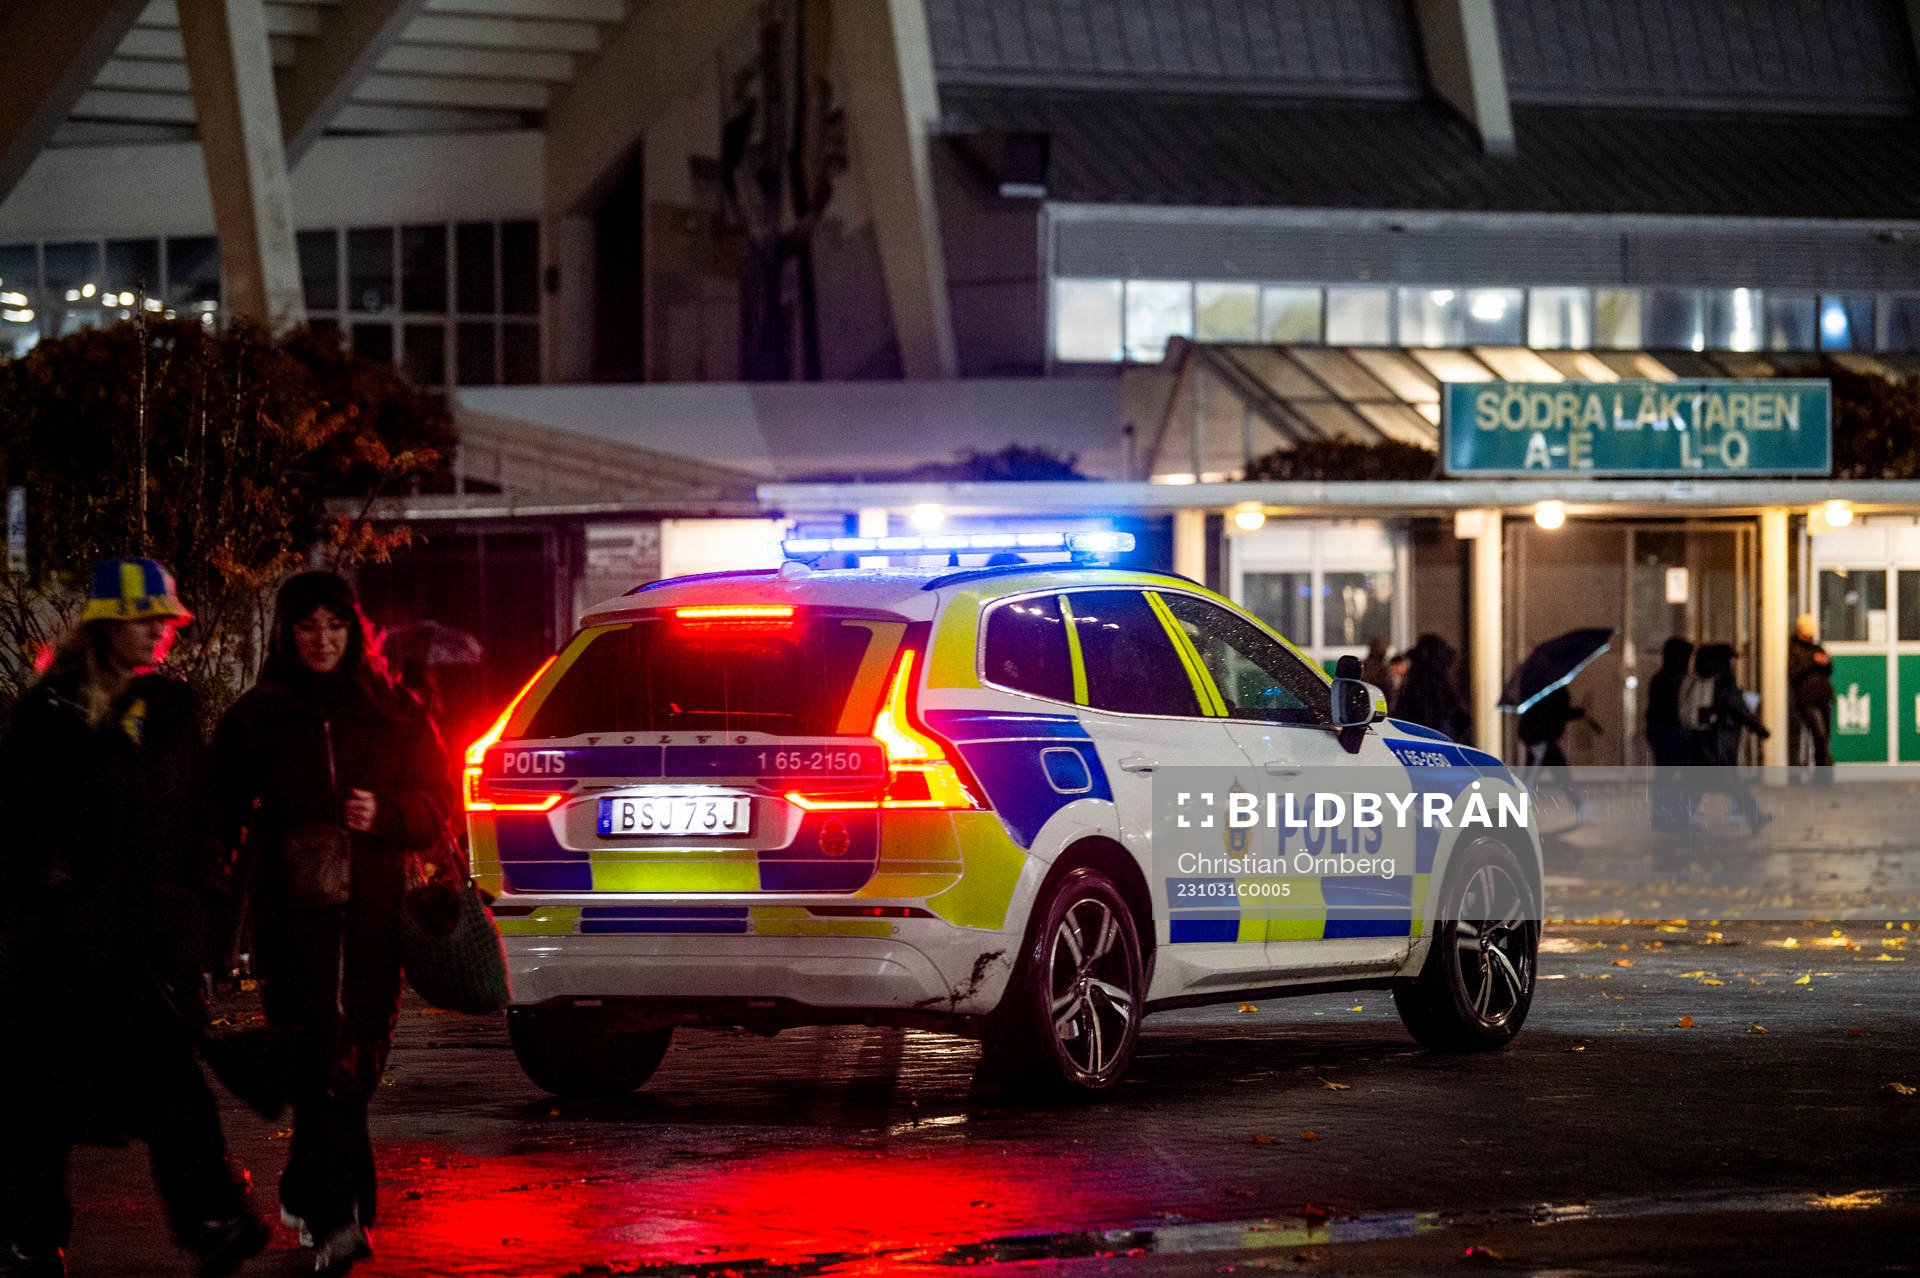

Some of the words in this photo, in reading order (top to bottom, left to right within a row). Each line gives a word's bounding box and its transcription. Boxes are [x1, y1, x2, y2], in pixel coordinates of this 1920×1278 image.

[1475, 384, 1606, 431] SÖDRA
[1612, 384, 1800, 432] LÄKTAREN
[1523, 431, 1595, 469] A-E
[1679, 431, 1750, 469] L-Q
[587, 735, 748, 746] VOLVO
[503, 751, 566, 774] POLIS
[757, 752, 767, 769] 1
[775, 751, 862, 771] 65-2150
[622, 802, 674, 831] BSJ
[684, 801, 738, 831] 73J
